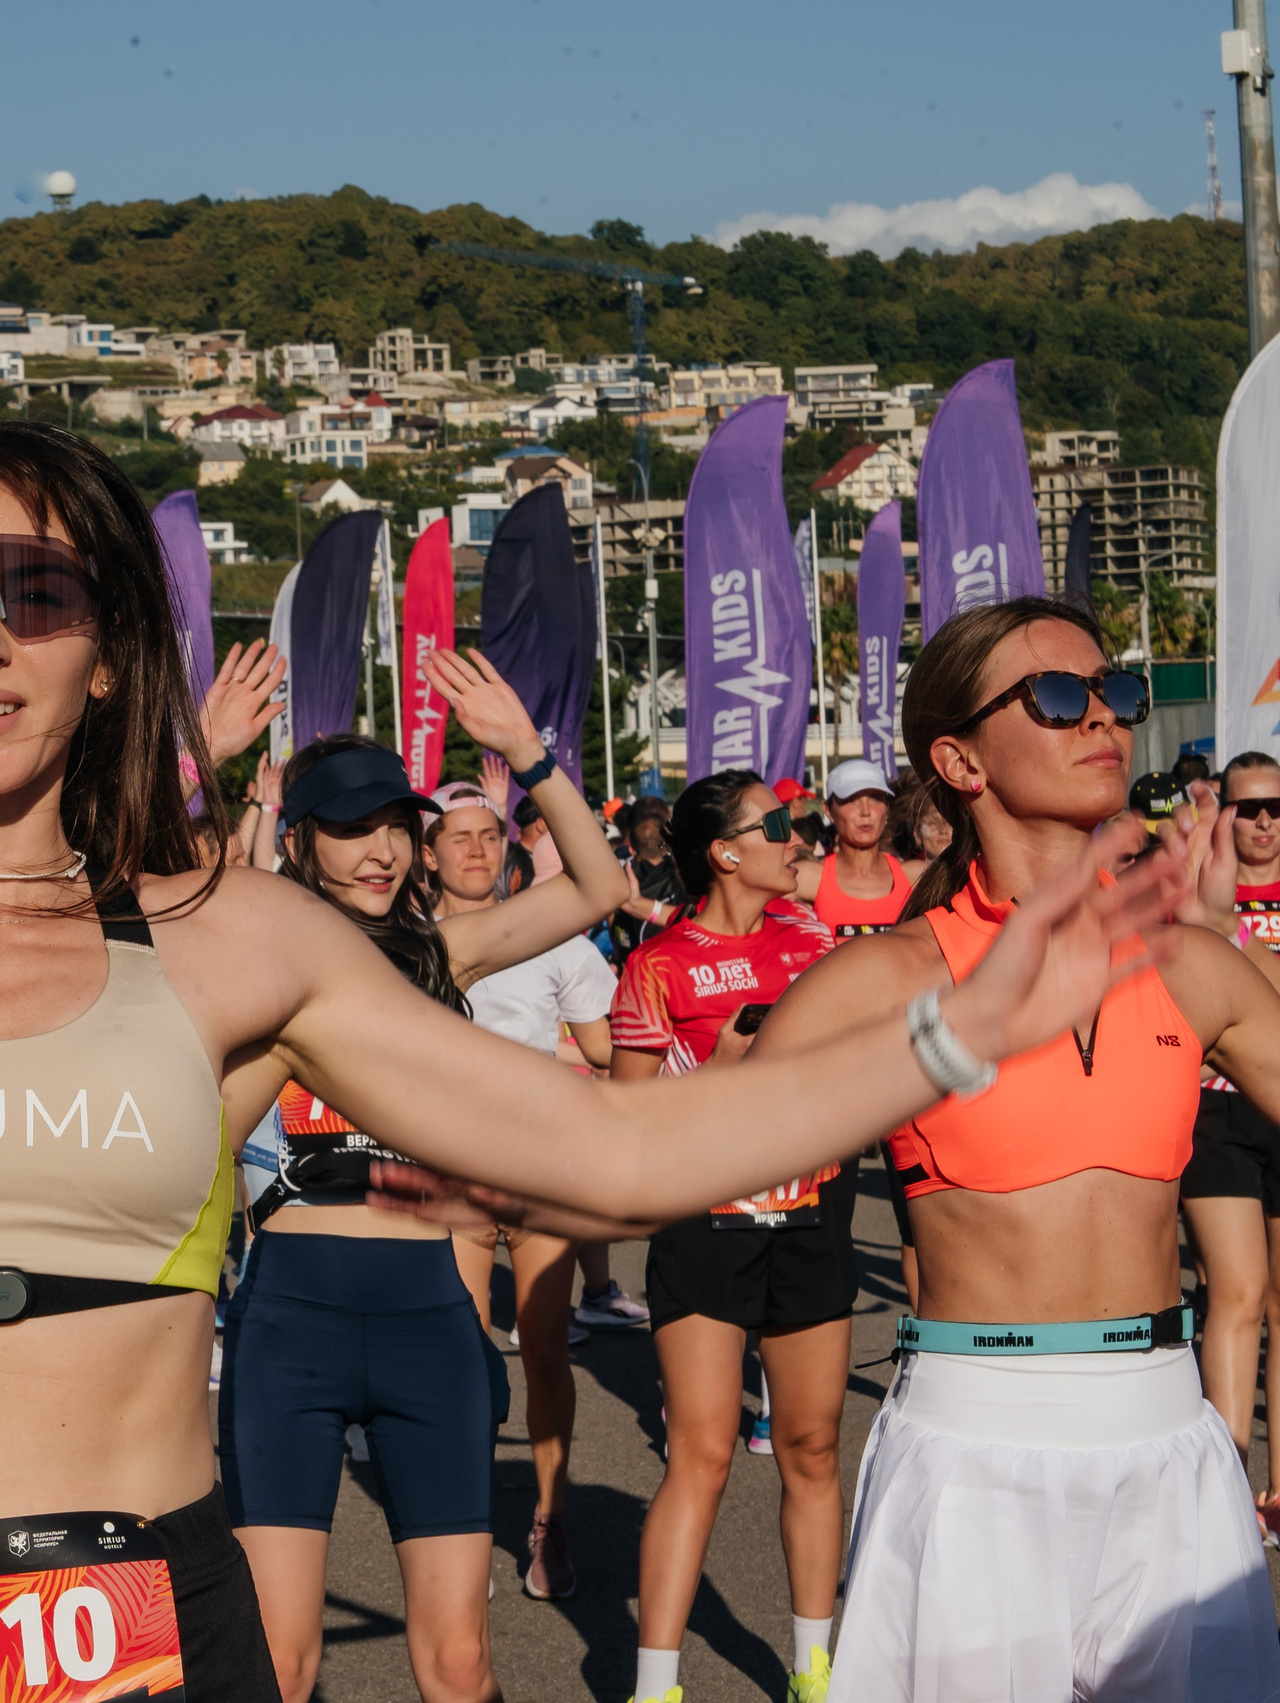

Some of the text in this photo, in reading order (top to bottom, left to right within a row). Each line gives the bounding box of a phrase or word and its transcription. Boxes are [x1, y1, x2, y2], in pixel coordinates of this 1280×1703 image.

[710, 569, 754, 777] TAR KIDS
[865, 635, 881, 706] KIDS
[688, 963, 753, 987] 10 лет
[694, 976, 759, 998] SIRIUS SOCHI
[754, 1212, 788, 1225] ИРИНА
[974, 1332, 1034, 1348] IRONMAN
[1103, 1326, 1153, 1344] IRONMA
[32, 1530, 68, 1538] ФЕДЕРАЛЬНАЯ
[98, 1536, 126, 1544] SIRIUS
